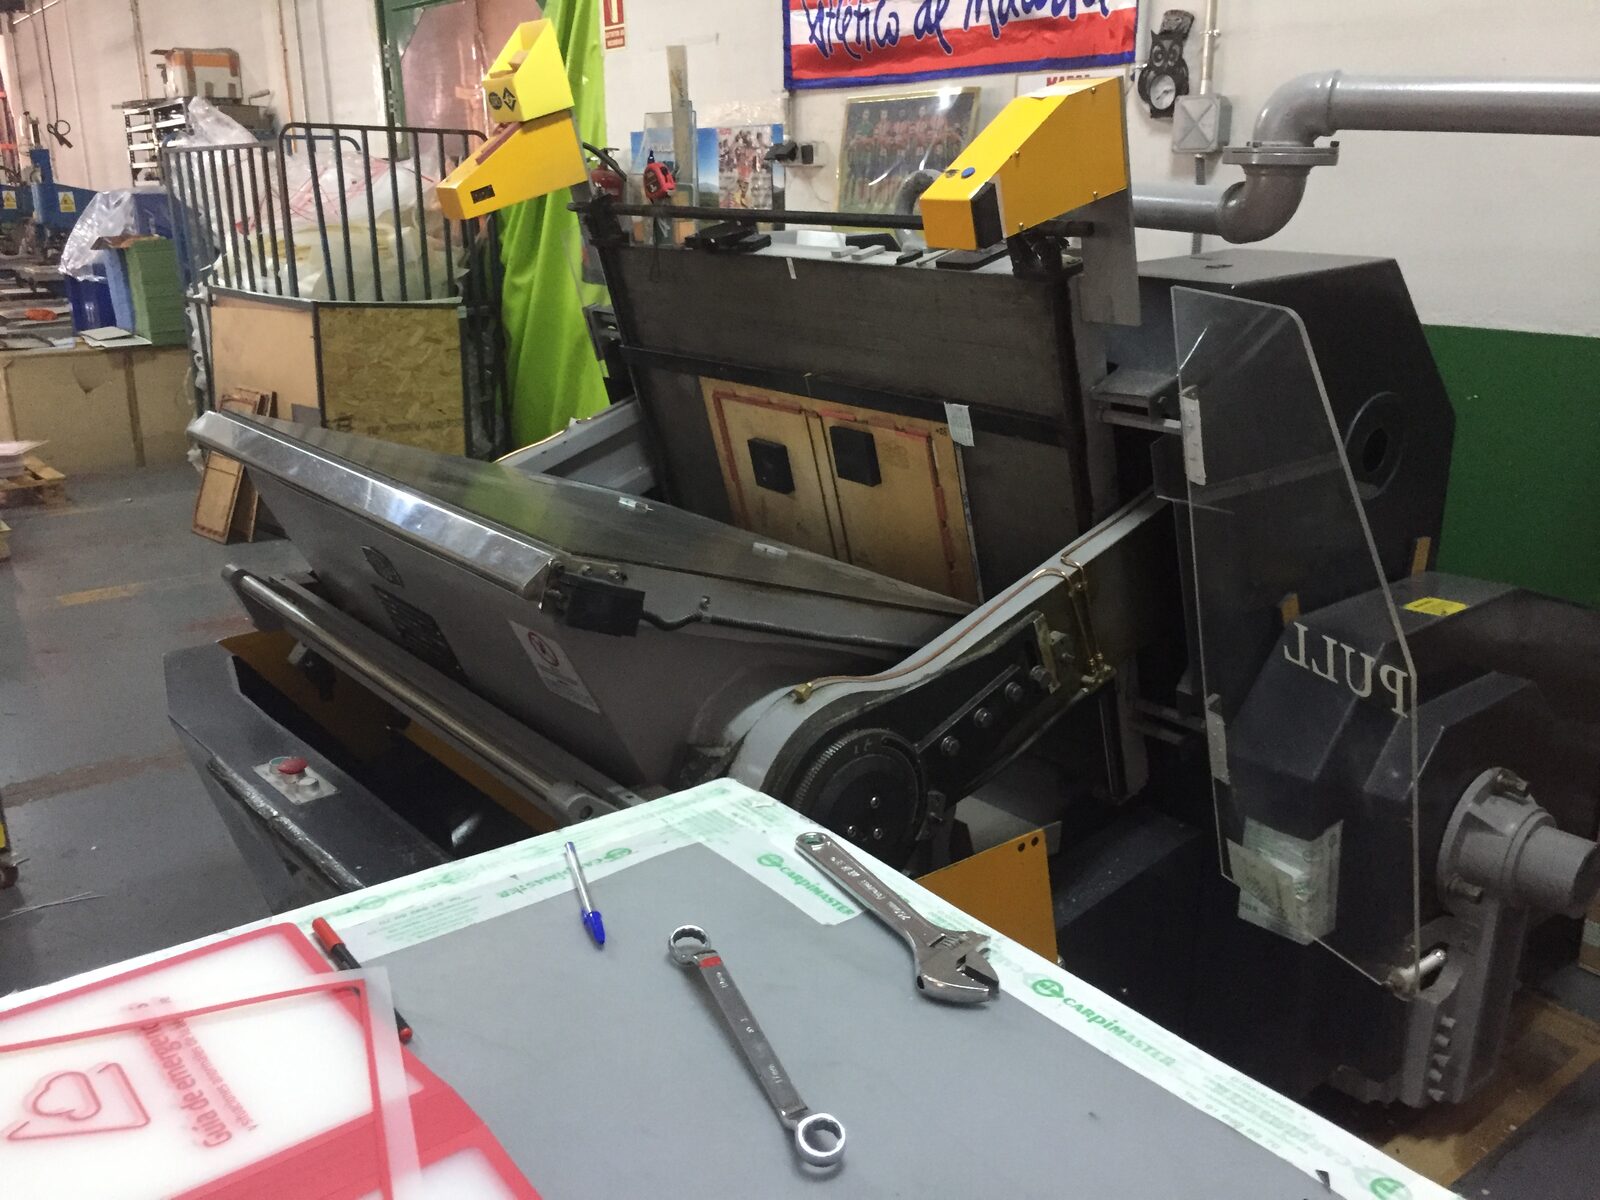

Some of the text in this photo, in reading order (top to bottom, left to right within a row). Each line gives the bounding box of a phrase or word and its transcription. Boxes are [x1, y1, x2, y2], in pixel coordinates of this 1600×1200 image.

[913, 0, 953, 55] de
[180, 1089, 210, 1112] de
[216, 1083, 254, 1128] situaciones
[191, 1109, 233, 1148] Guía
